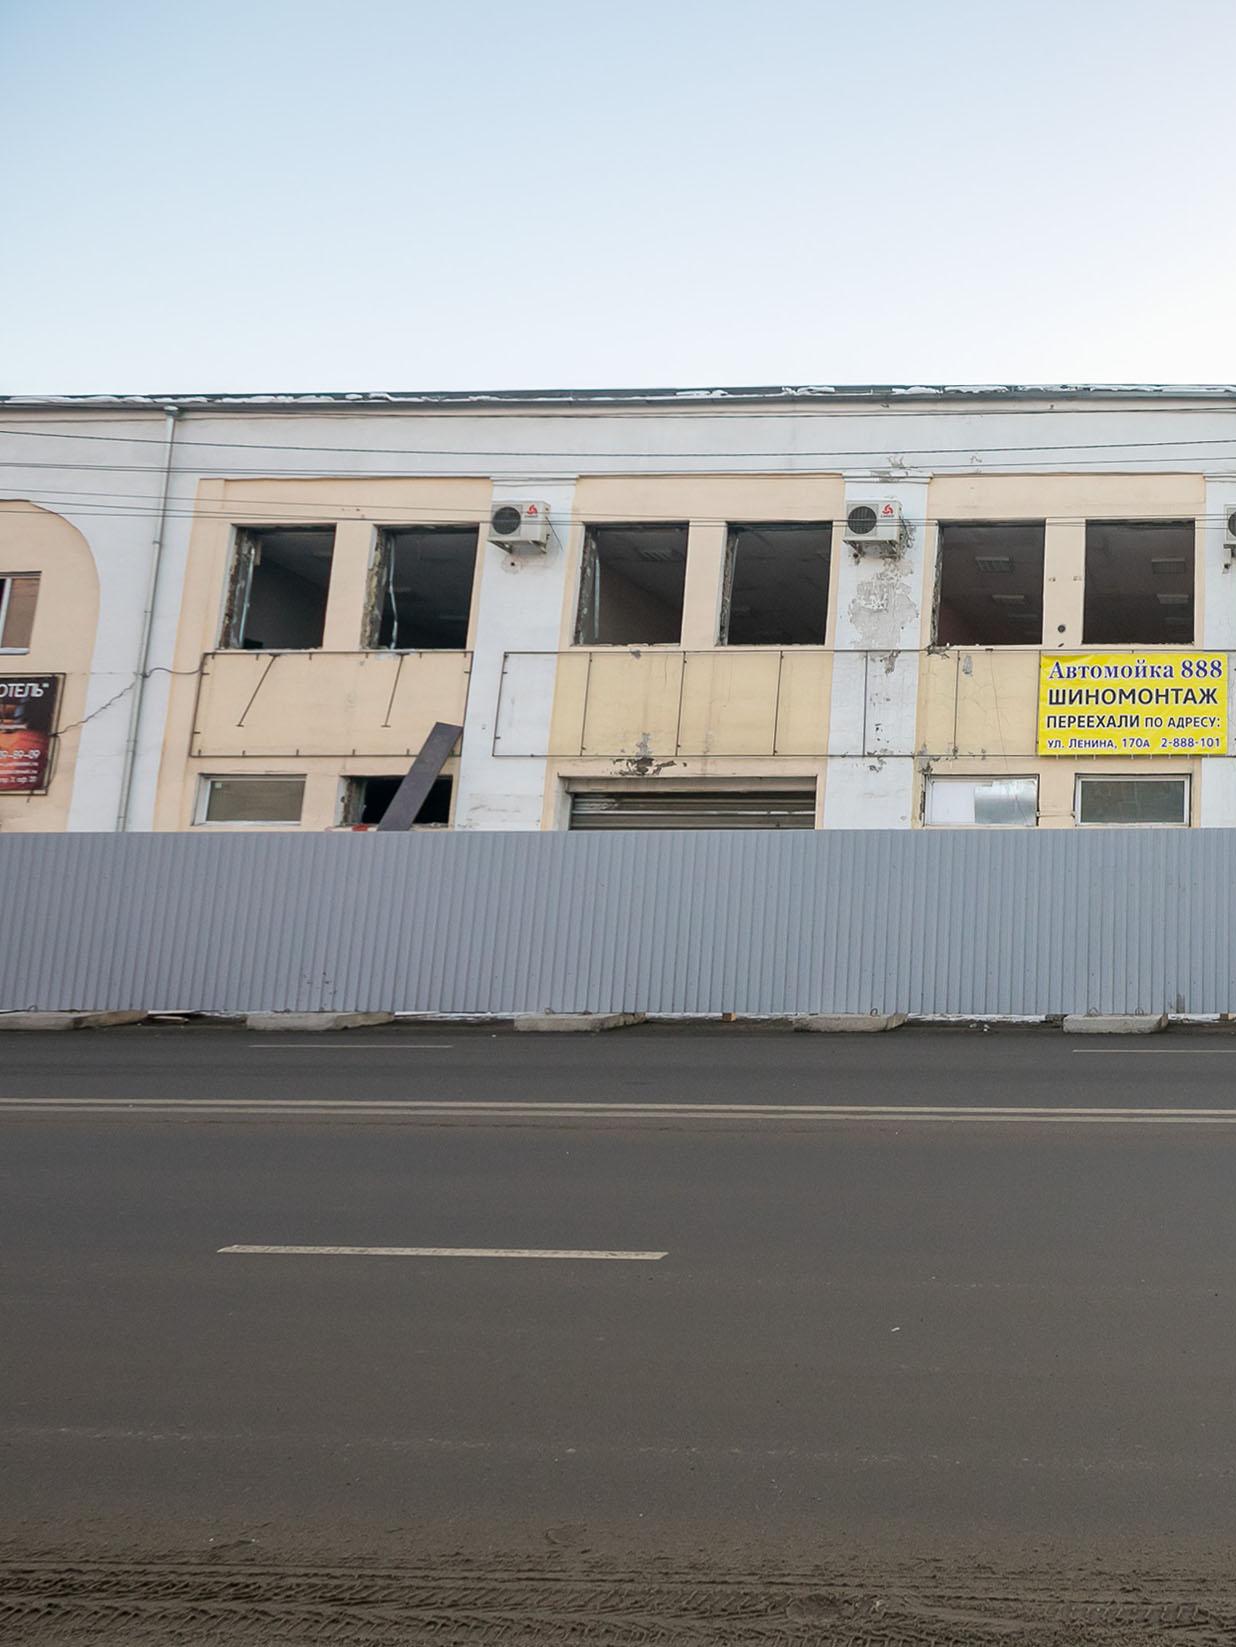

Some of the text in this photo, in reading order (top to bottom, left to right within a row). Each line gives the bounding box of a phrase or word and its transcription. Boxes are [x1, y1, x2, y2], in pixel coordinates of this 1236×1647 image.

[1048, 659, 1223, 679] Автомойка 888
[1048, 688, 1218, 706] ШИНОМОНТАЖ
[1046, 715, 1221, 729] ПЕРЕЕХАЛИ ПО АДРЕСУ:
[1161, 737, 1220, 748] 2-888-101
